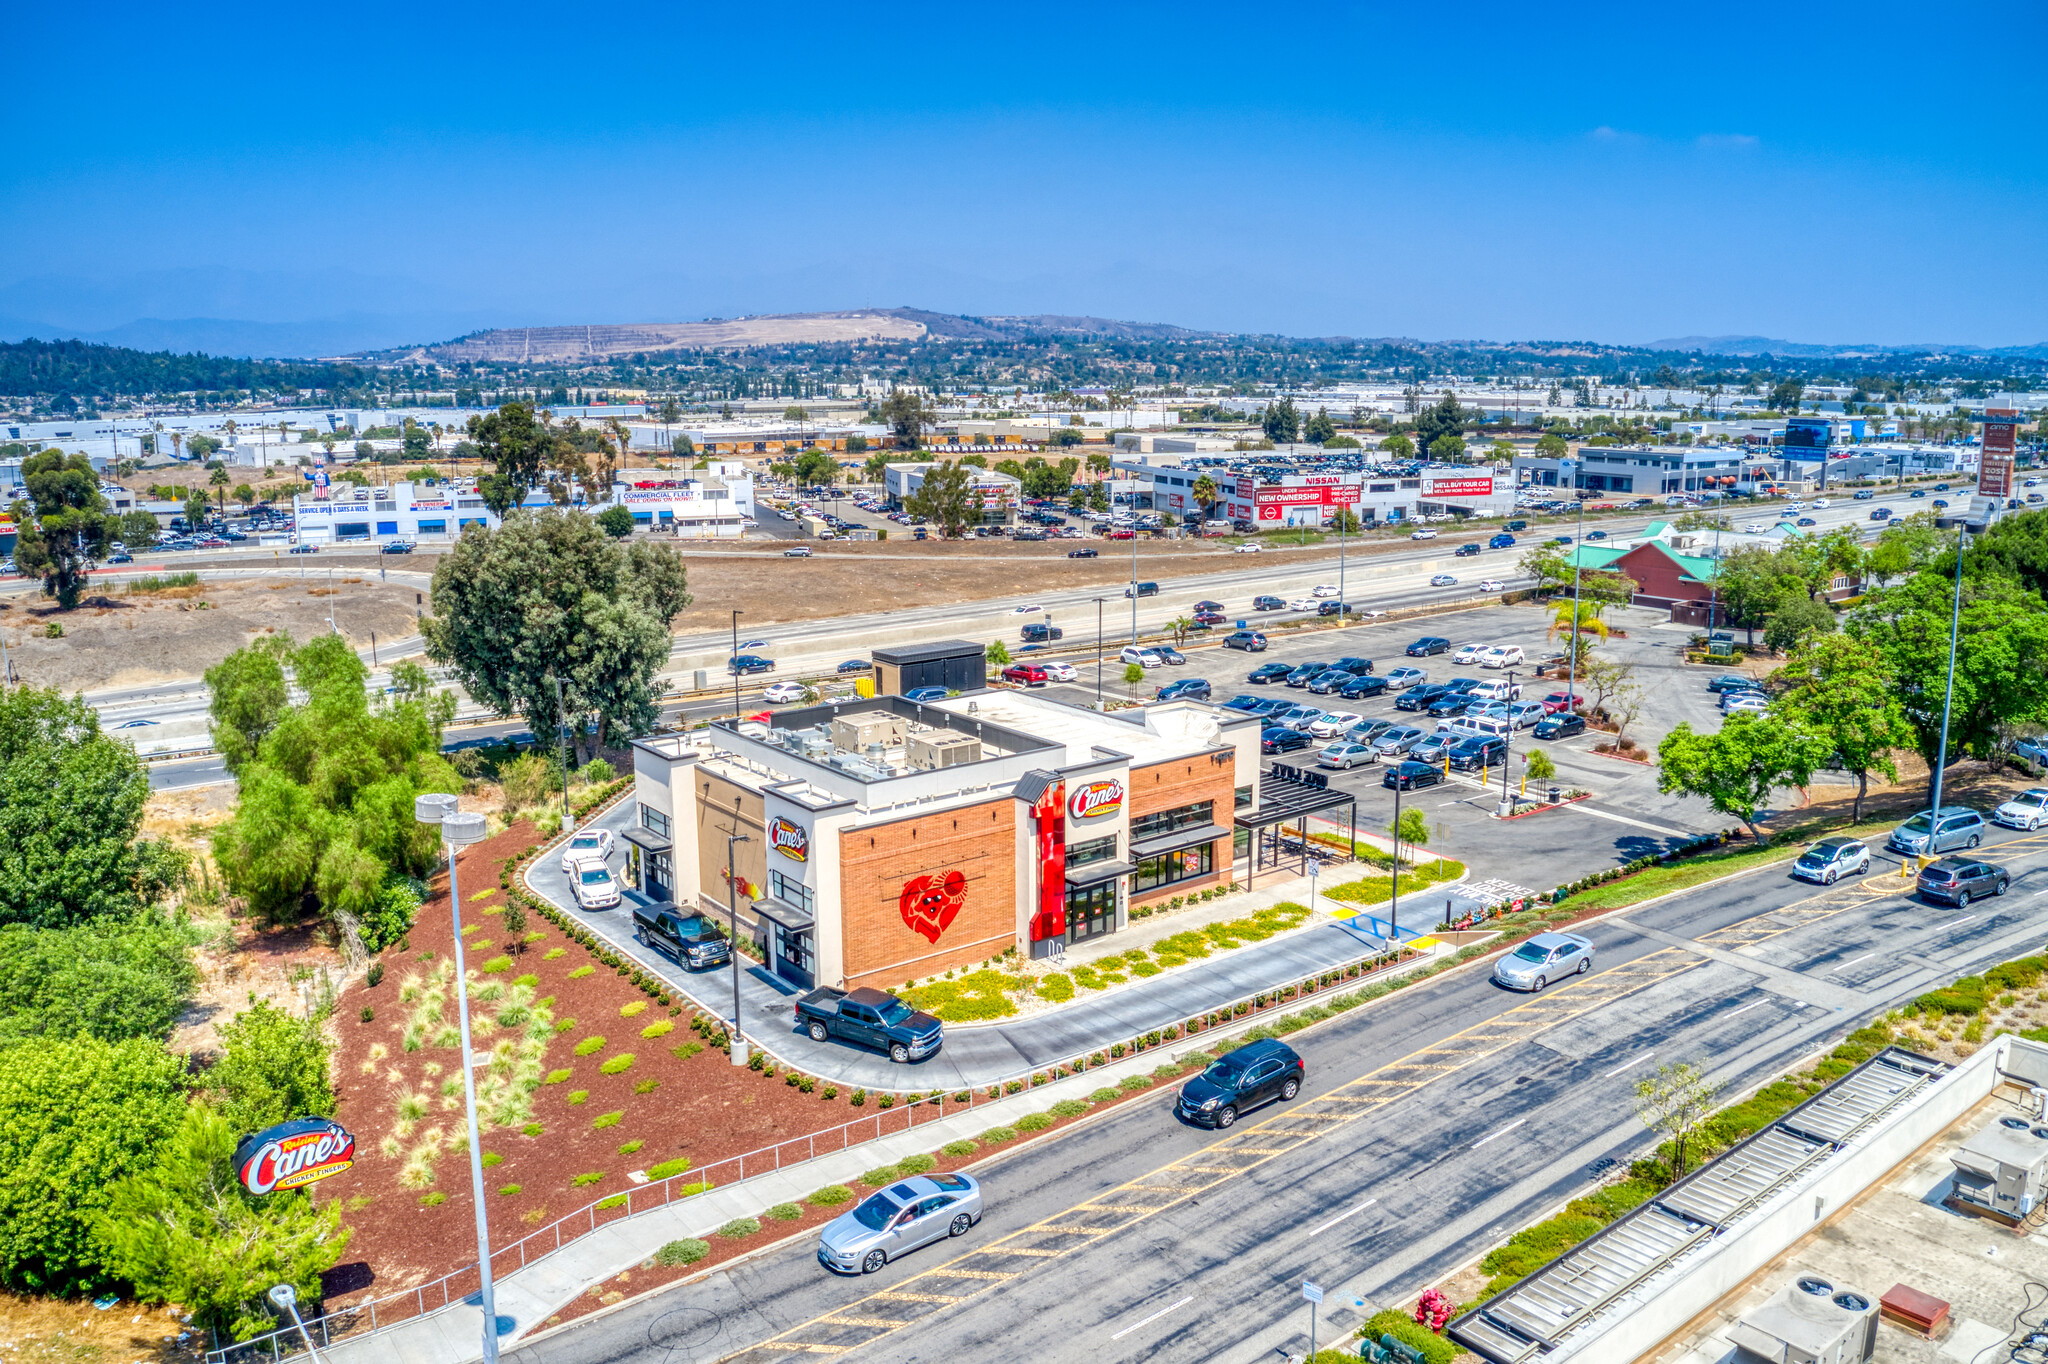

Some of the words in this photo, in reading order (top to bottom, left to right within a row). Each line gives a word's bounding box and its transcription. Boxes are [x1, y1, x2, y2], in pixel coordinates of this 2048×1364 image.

[1306, 477, 1340, 485] NISSAN
[1277, 493, 1320, 501] OWNERSHIP
[1073, 780, 1124, 818] Cane's
[770, 818, 805, 848] Cane's
[1448, 888, 1481, 899] WAY
[1469, 881, 1502, 895] NOT
[1484, 878, 1535, 895] ENTER
[282, 1135, 320, 1152] Raising
[248, 1126, 353, 1195] Cane's
[284, 1172, 315, 1186] CHICKEN
[317, 1163, 347, 1176] FINGERS
